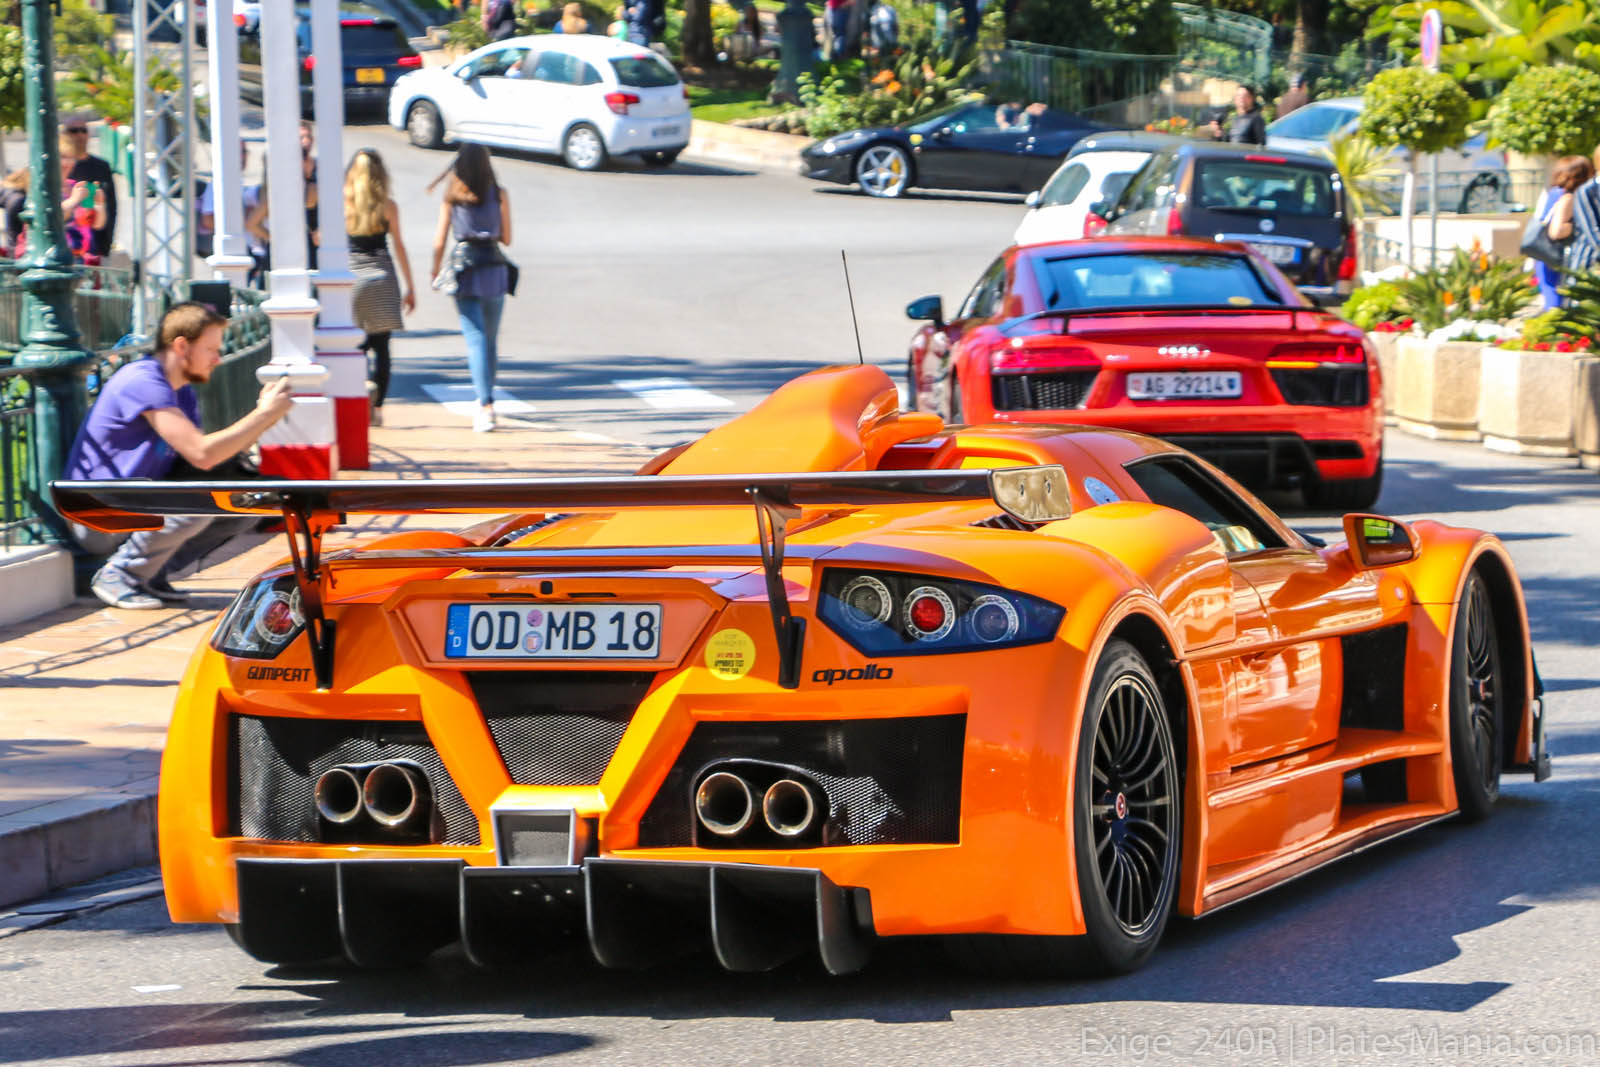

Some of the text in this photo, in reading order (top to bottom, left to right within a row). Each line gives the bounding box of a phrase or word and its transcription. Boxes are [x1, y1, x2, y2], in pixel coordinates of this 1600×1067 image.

[1145, 376, 1223, 394] AG 29214
[470, 611, 655, 651] OD MB 18
[452, 636, 462, 648] D
[247, 666, 312, 682] GUMPERT
[812, 664, 893, 686] apollo
